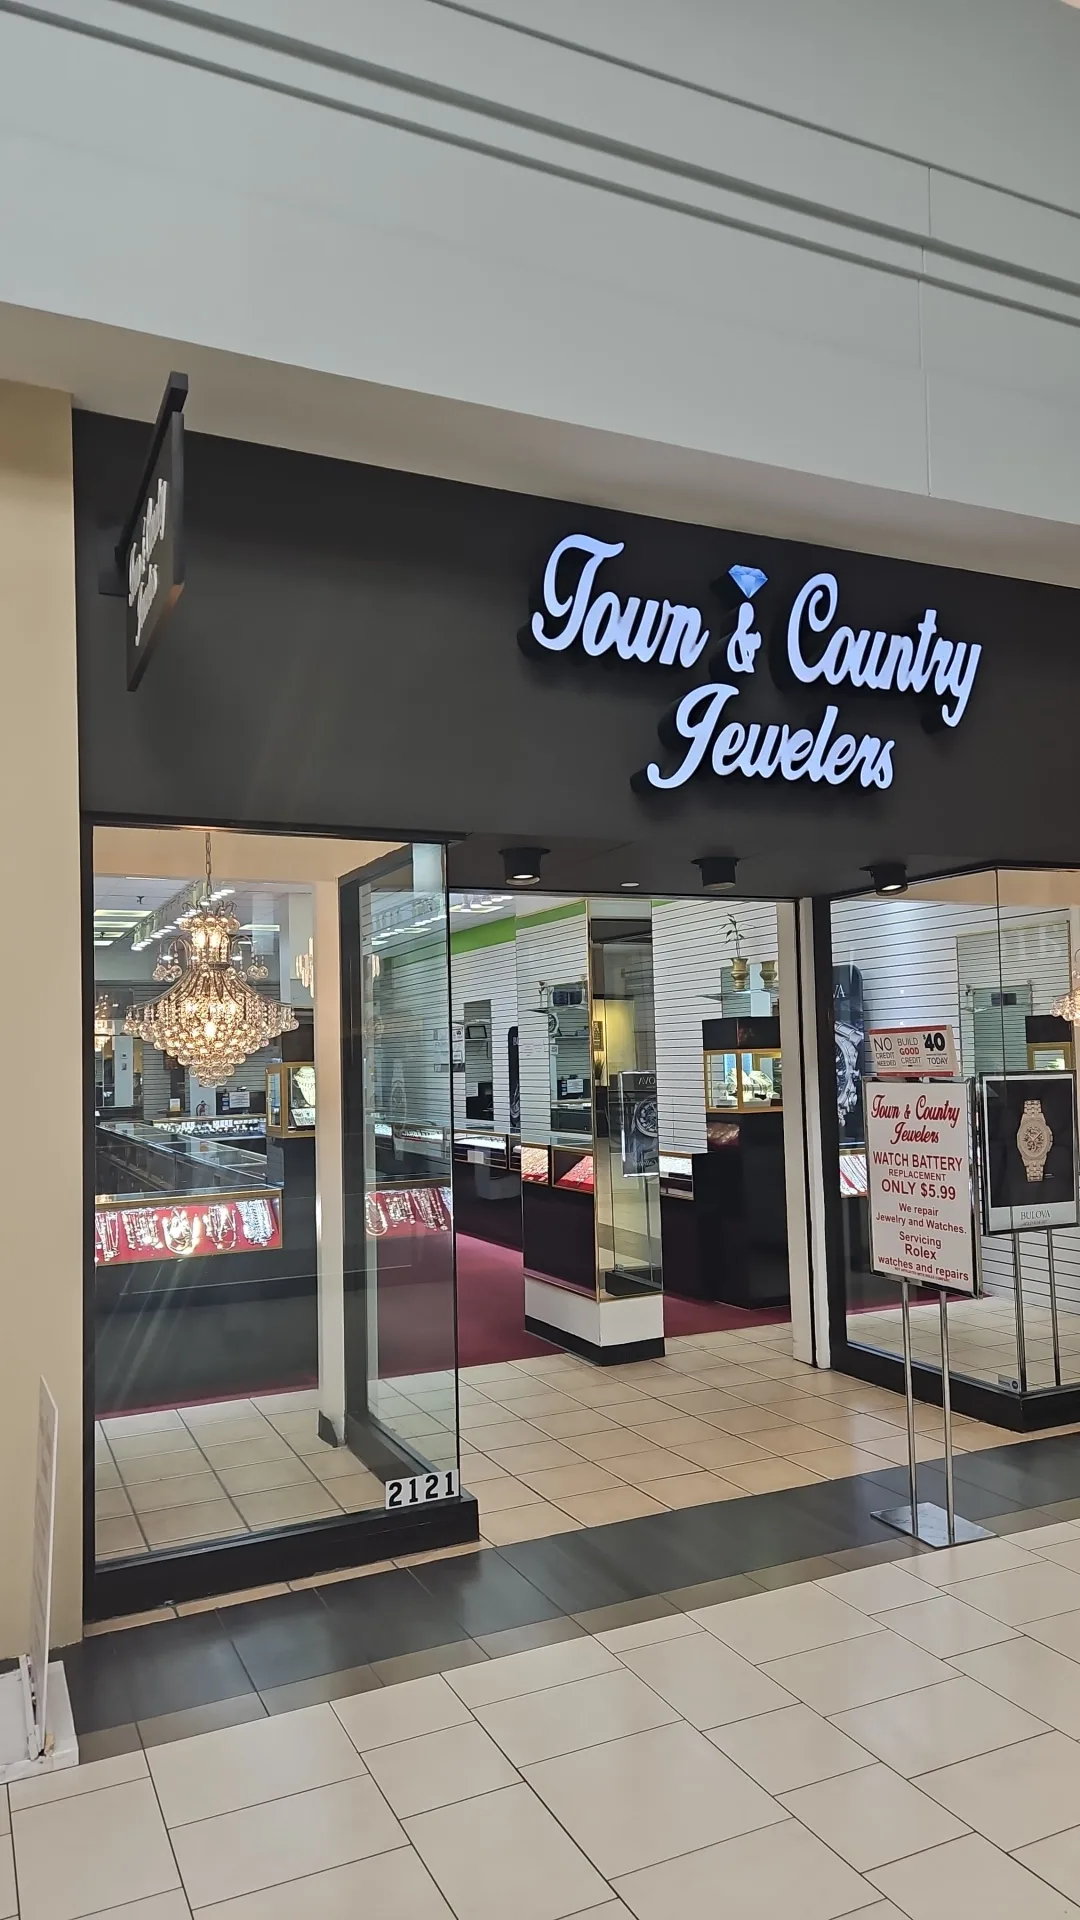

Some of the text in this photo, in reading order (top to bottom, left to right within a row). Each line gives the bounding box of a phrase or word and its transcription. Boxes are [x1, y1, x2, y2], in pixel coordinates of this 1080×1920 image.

[531, 533, 982, 728] Town & Country
[646, 683, 895, 789] Jewelers
[873, 1037, 892, 1051] NO
[897, 1037, 918, 1047] BUILD
[923, 1032, 945, 1051] $40
[875, 1051, 895, 1060] CREDIT
[900, 1047, 920, 1056] GOOD
[900, 1056, 922, 1065] CREDIT
[926, 1056, 949, 1065] TODAY
[871, 1094, 960, 1129] Town & Country
[889, 1121, 940, 1145] Jewelers
[872, 1150, 963, 1172] WATCH BATTERY
[888, 1168, 947, 1182] REPLACEMENT
[881, 1178, 956, 1200] ONLY $5.99
[898, 1202, 940, 1217] We repair
[1020, 1209, 1051, 1220] BULOVA
[875, 1212, 967, 1234] Jewelry and Watches.
[899, 1230, 942, 1250] Servicing
[904, 1243, 937, 1260] Rolex
[877, 1255, 914, 1270] watches
[915, 1263, 933, 1274] and
[935, 1267, 969, 1281] repairs
[388, 1471, 455, 1508] 2121
